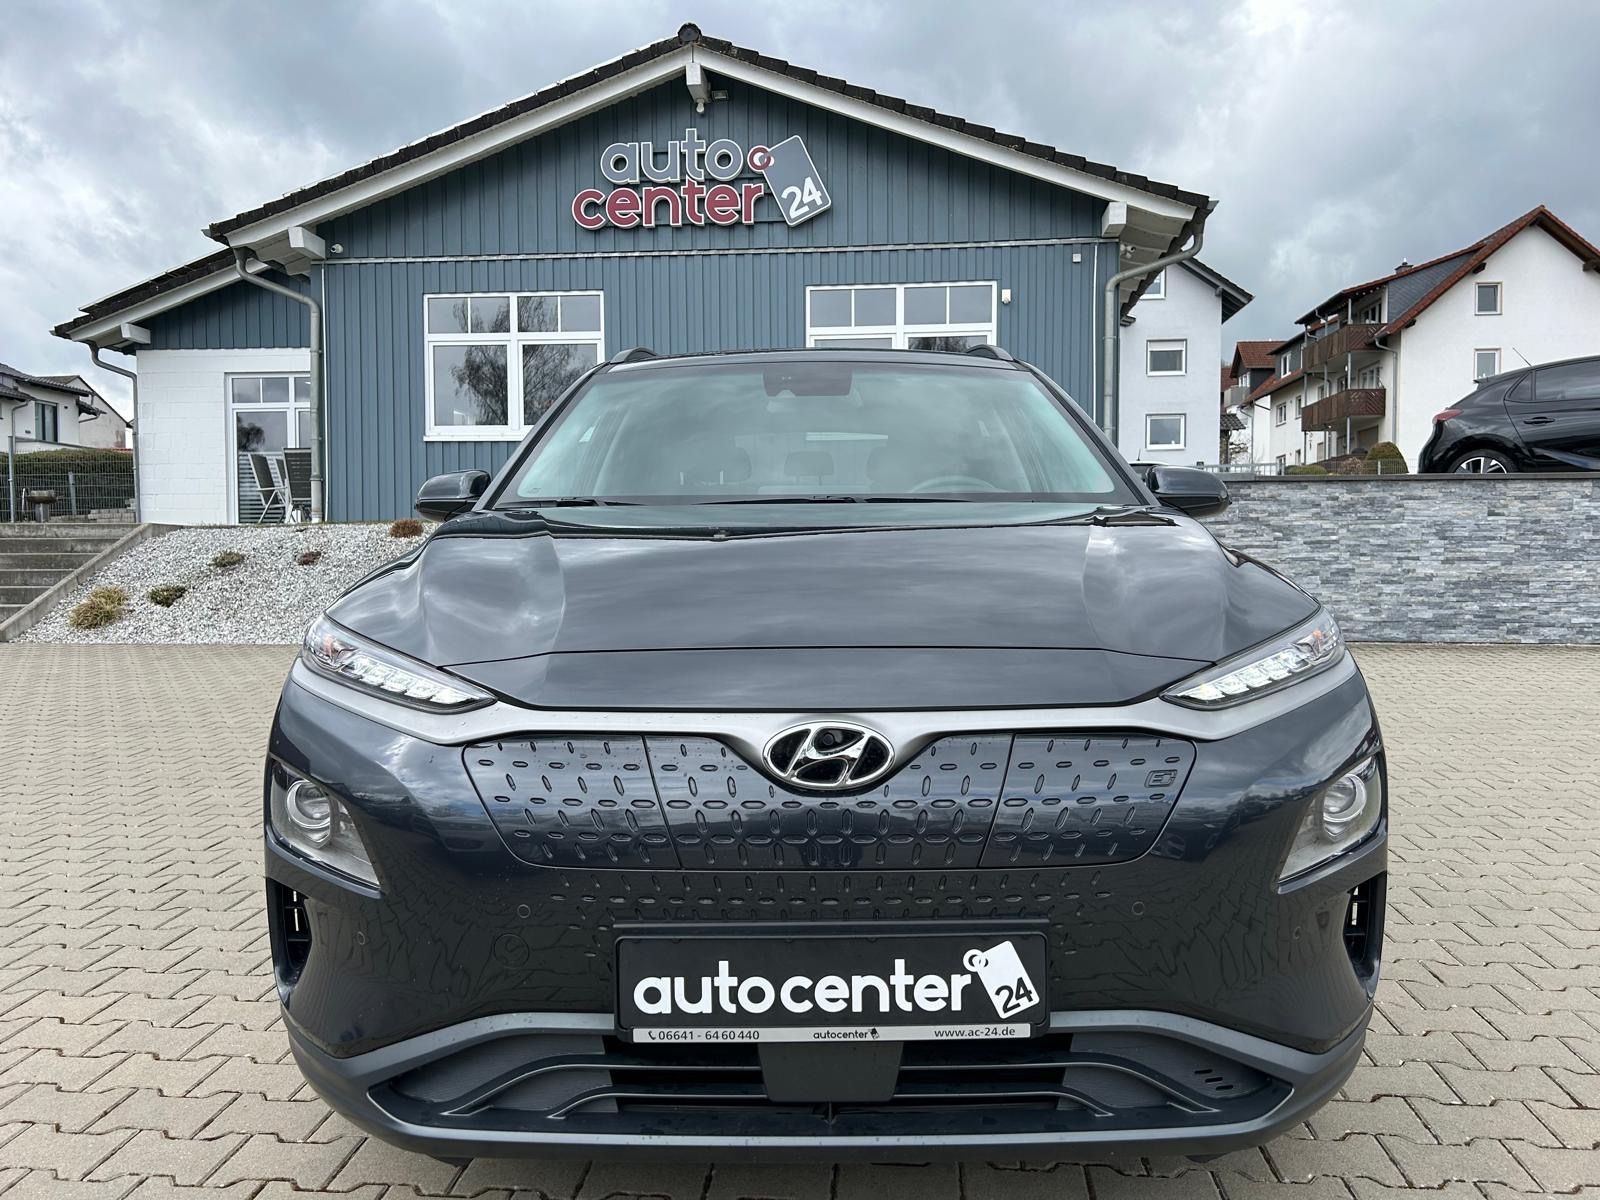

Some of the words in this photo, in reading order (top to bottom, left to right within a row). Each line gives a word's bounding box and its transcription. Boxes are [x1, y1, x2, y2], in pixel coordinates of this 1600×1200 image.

[601, 128, 743, 184] auto
[572, 178, 764, 229] center
[781, 176, 822, 219] 24
[995, 977, 1032, 1013] 24
[658, 1031, 694, 1040] 06641
[813, 1030, 868, 1039] autocenter
[934, 1026, 1016, 1038] www.ac-24.de
